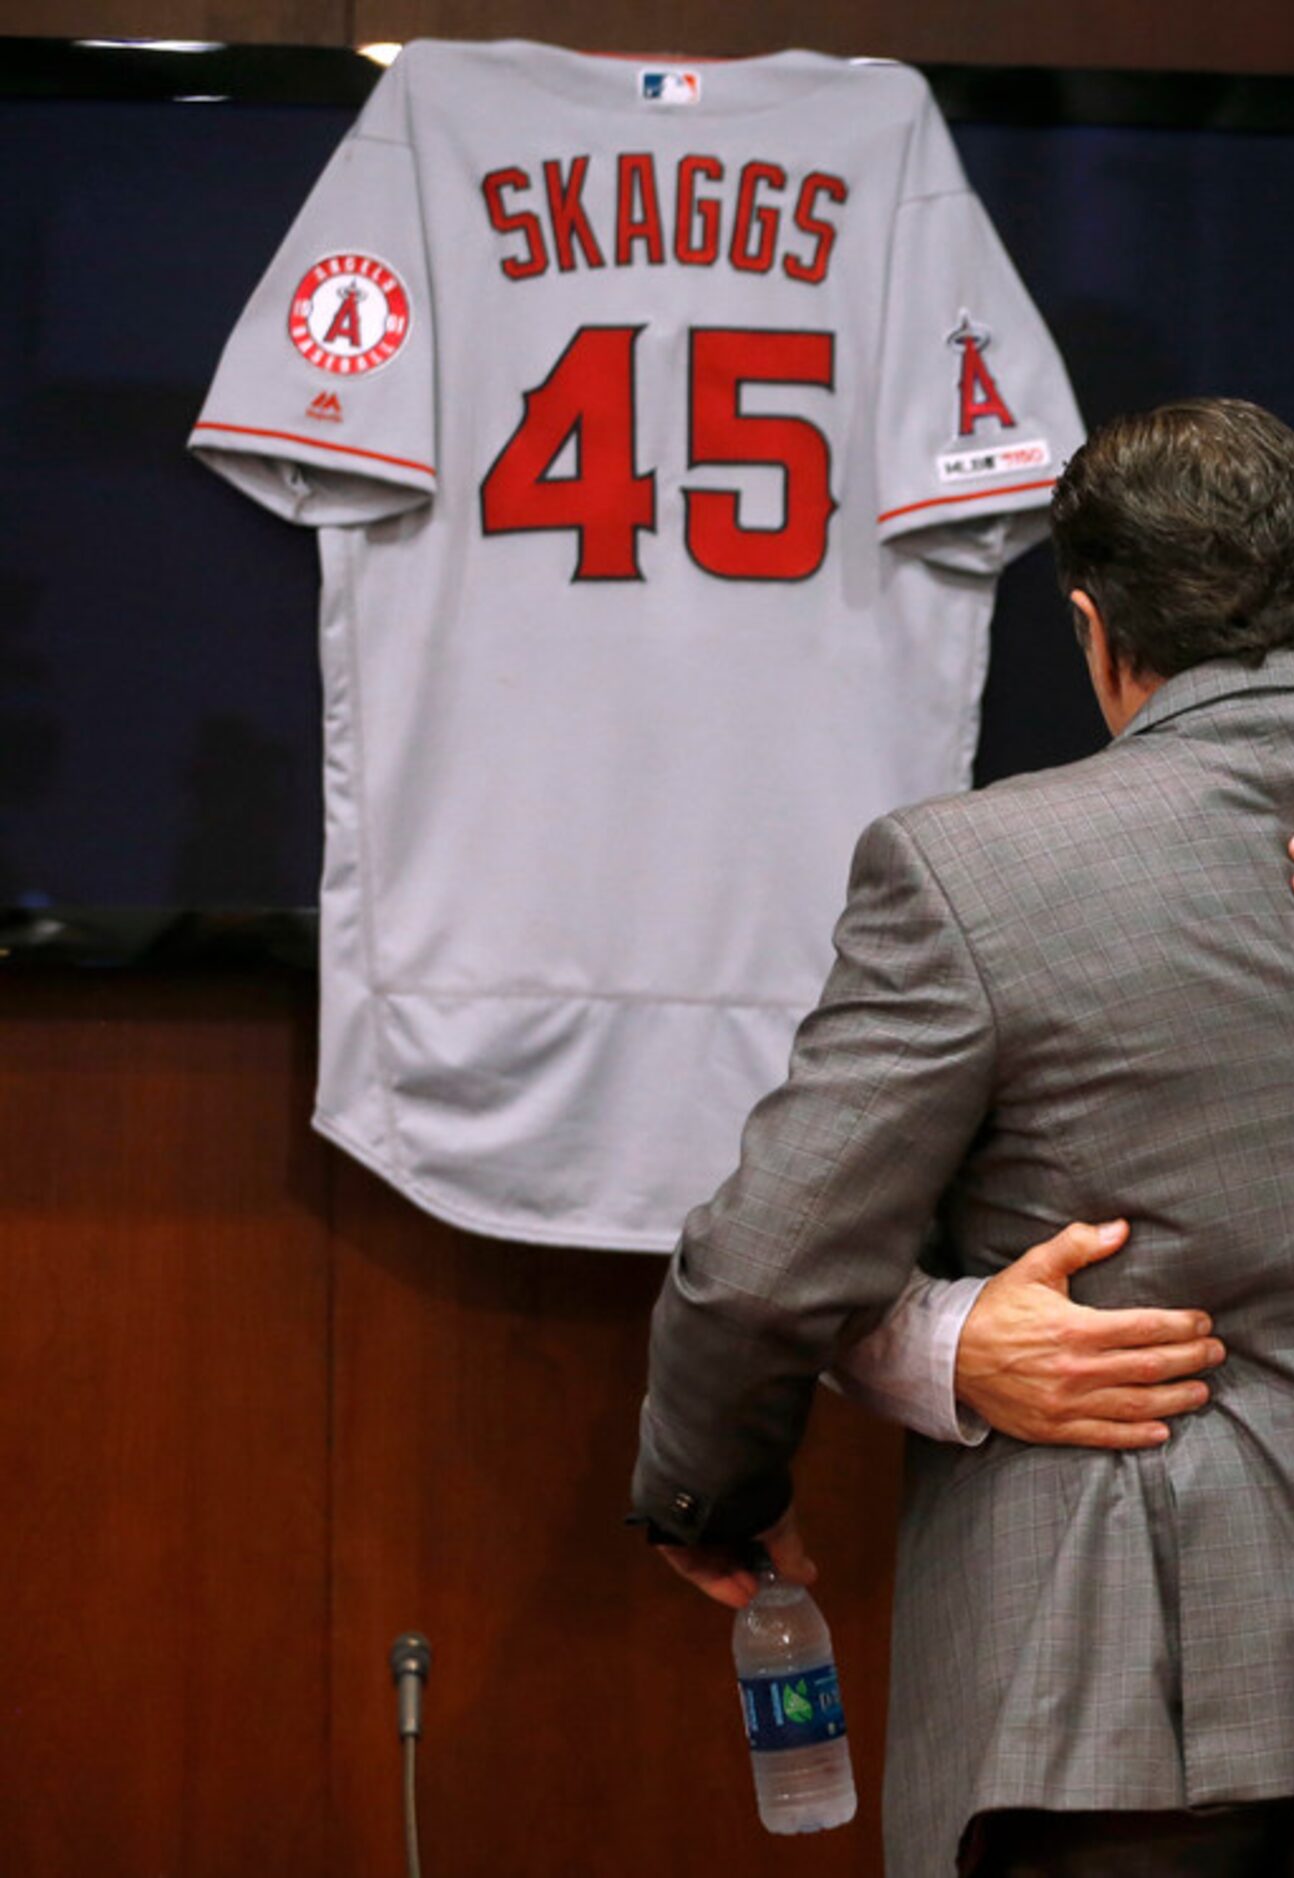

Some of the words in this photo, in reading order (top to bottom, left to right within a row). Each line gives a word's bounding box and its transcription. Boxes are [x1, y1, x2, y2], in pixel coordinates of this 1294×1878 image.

[481, 152, 849, 285] SKAGGS
[314, 256, 398, 292] ANGELS
[292, 325, 396, 372] BASEBALL
[323, 288, 362, 348] A
[958, 333, 1016, 436] A
[479, 322, 840, 585] 45
